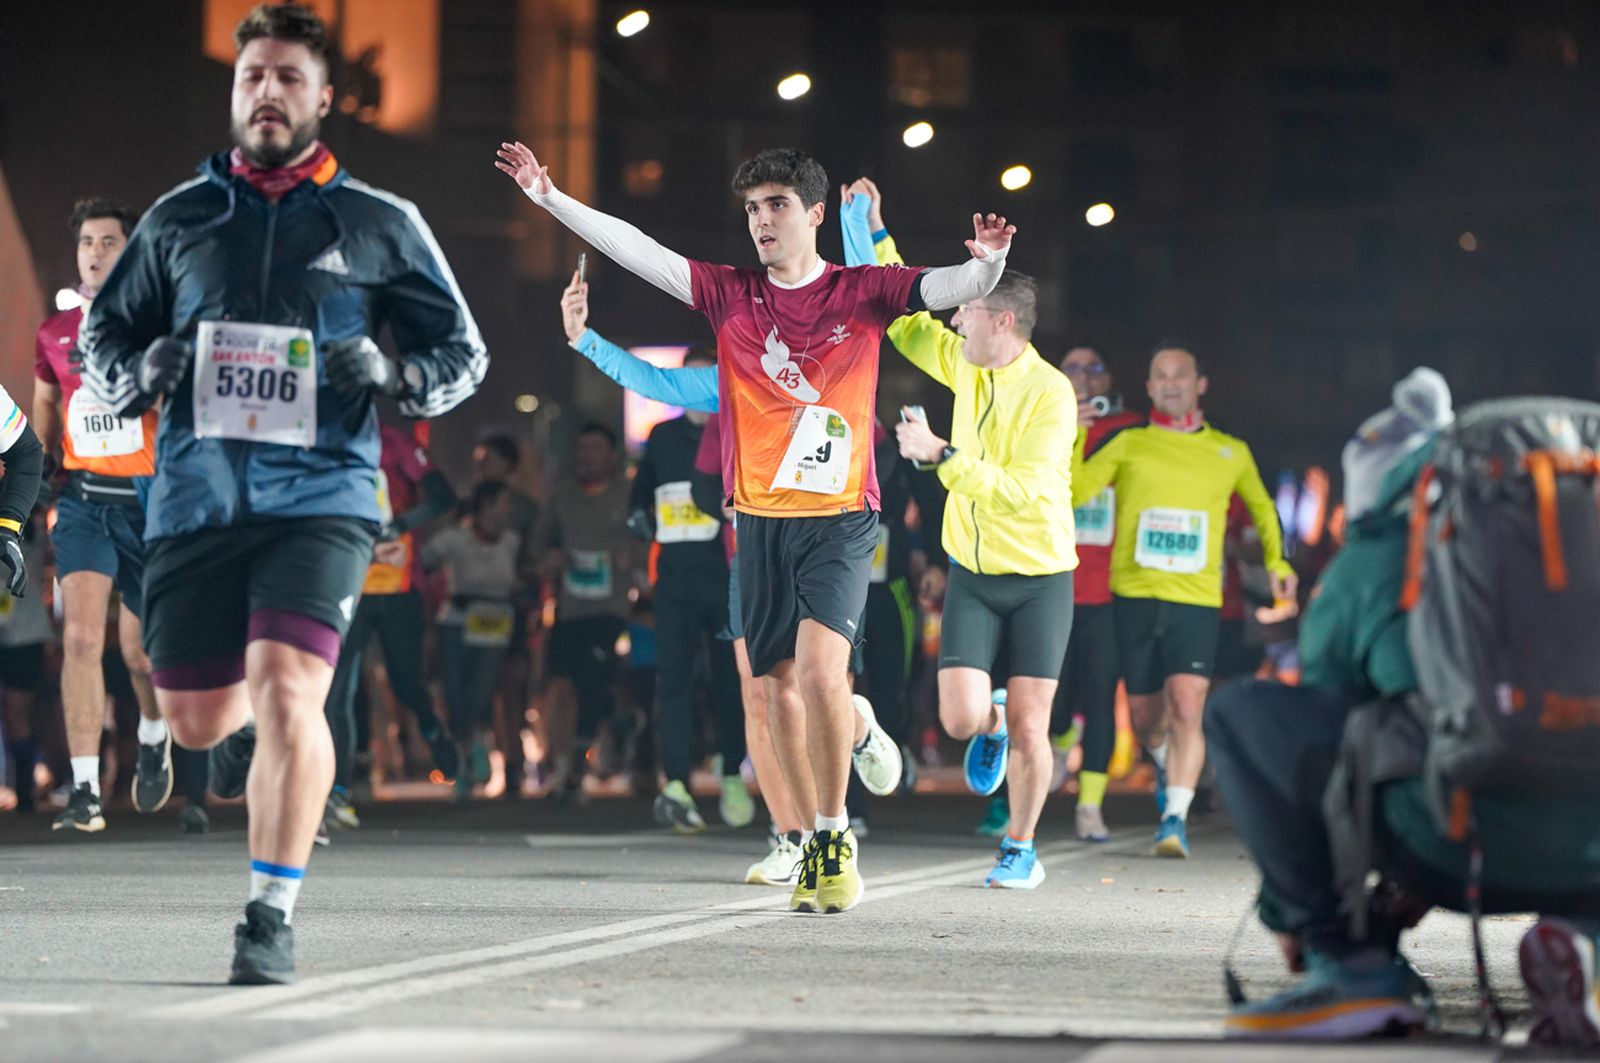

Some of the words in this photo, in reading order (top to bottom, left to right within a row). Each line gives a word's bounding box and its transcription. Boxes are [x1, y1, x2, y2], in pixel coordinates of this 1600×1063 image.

[216, 365, 298, 403] 5306
[776, 367, 801, 390] 43
[83, 413, 123, 433] 1601
[797, 461, 817, 471] Miguel
[1147, 530, 1199, 552] 12680
